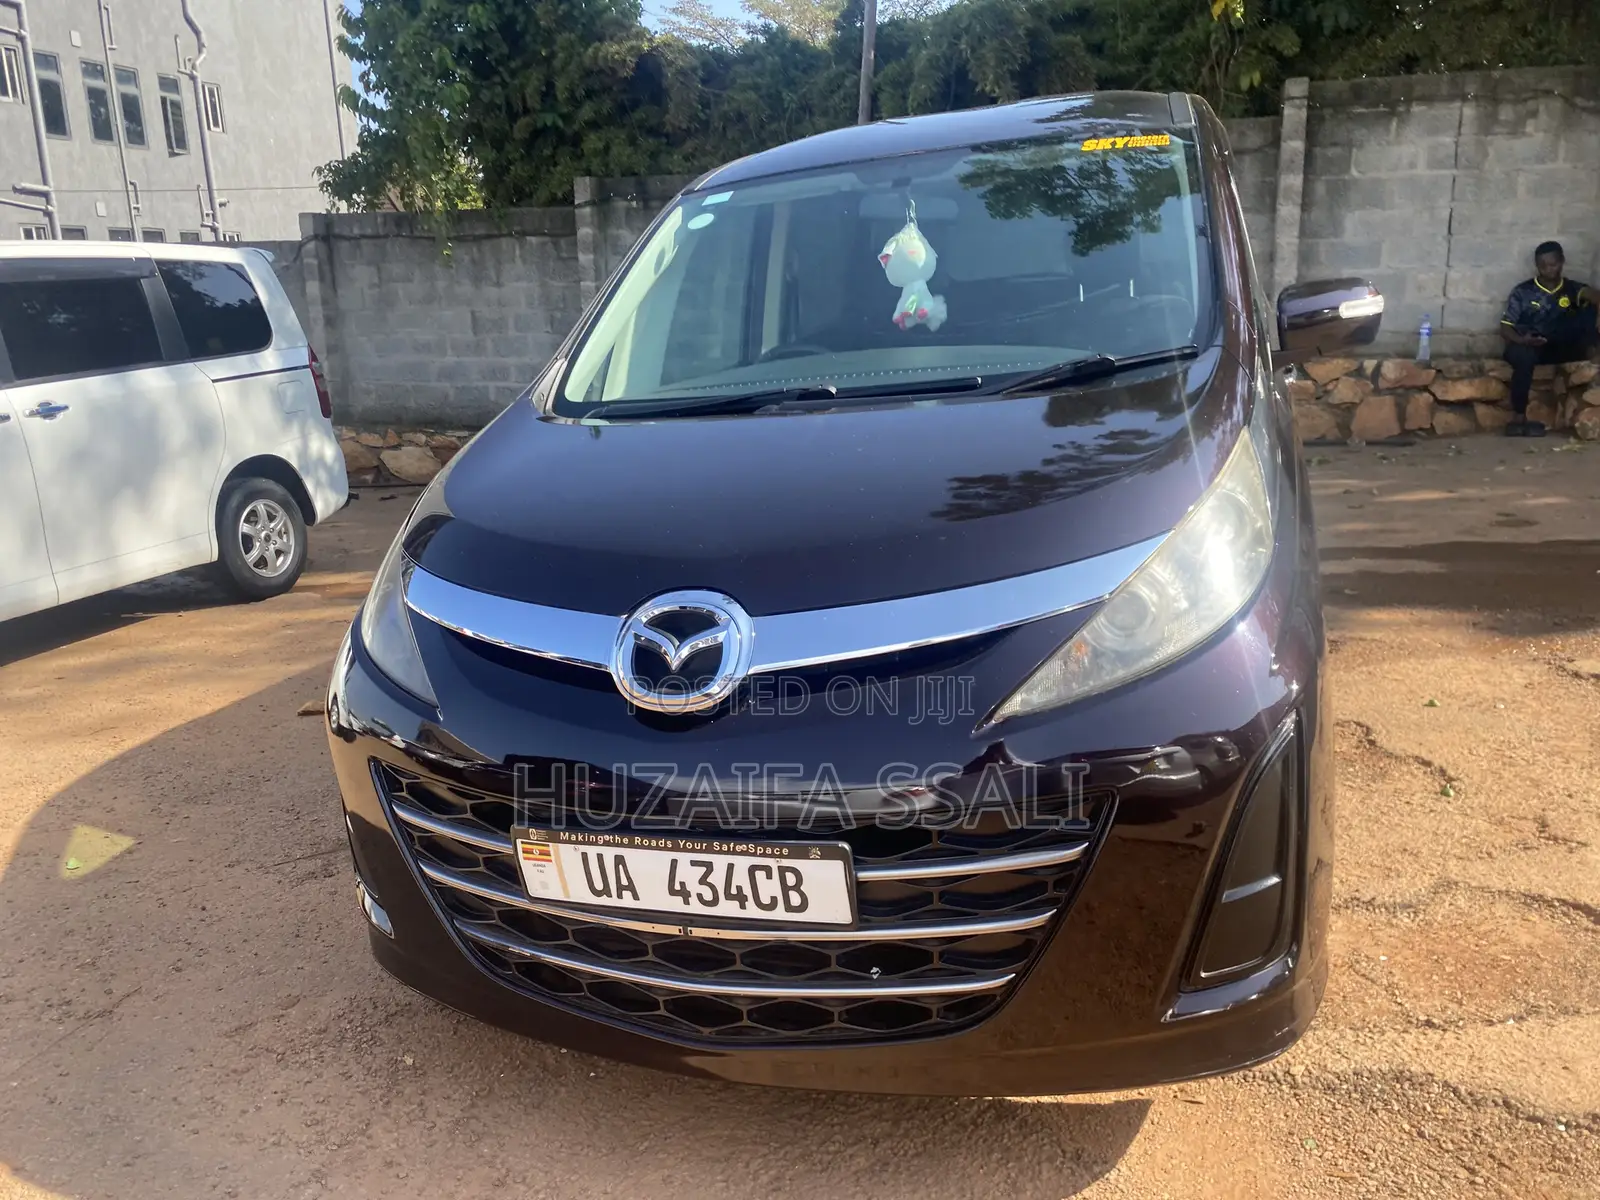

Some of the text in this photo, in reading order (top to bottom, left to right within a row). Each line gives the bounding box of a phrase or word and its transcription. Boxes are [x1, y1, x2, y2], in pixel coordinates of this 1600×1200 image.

[1081, 136, 1130, 151] SKY
[560, 831, 603, 845] Making
[609, 832, 629, 844] the
[634, 836, 672, 848] Roads
[678, 839, 707, 850] Your
[713, 842, 742, 852] Safe
[748, 845, 789, 856] Space
[581, 851, 809, 914] UA 434CB
